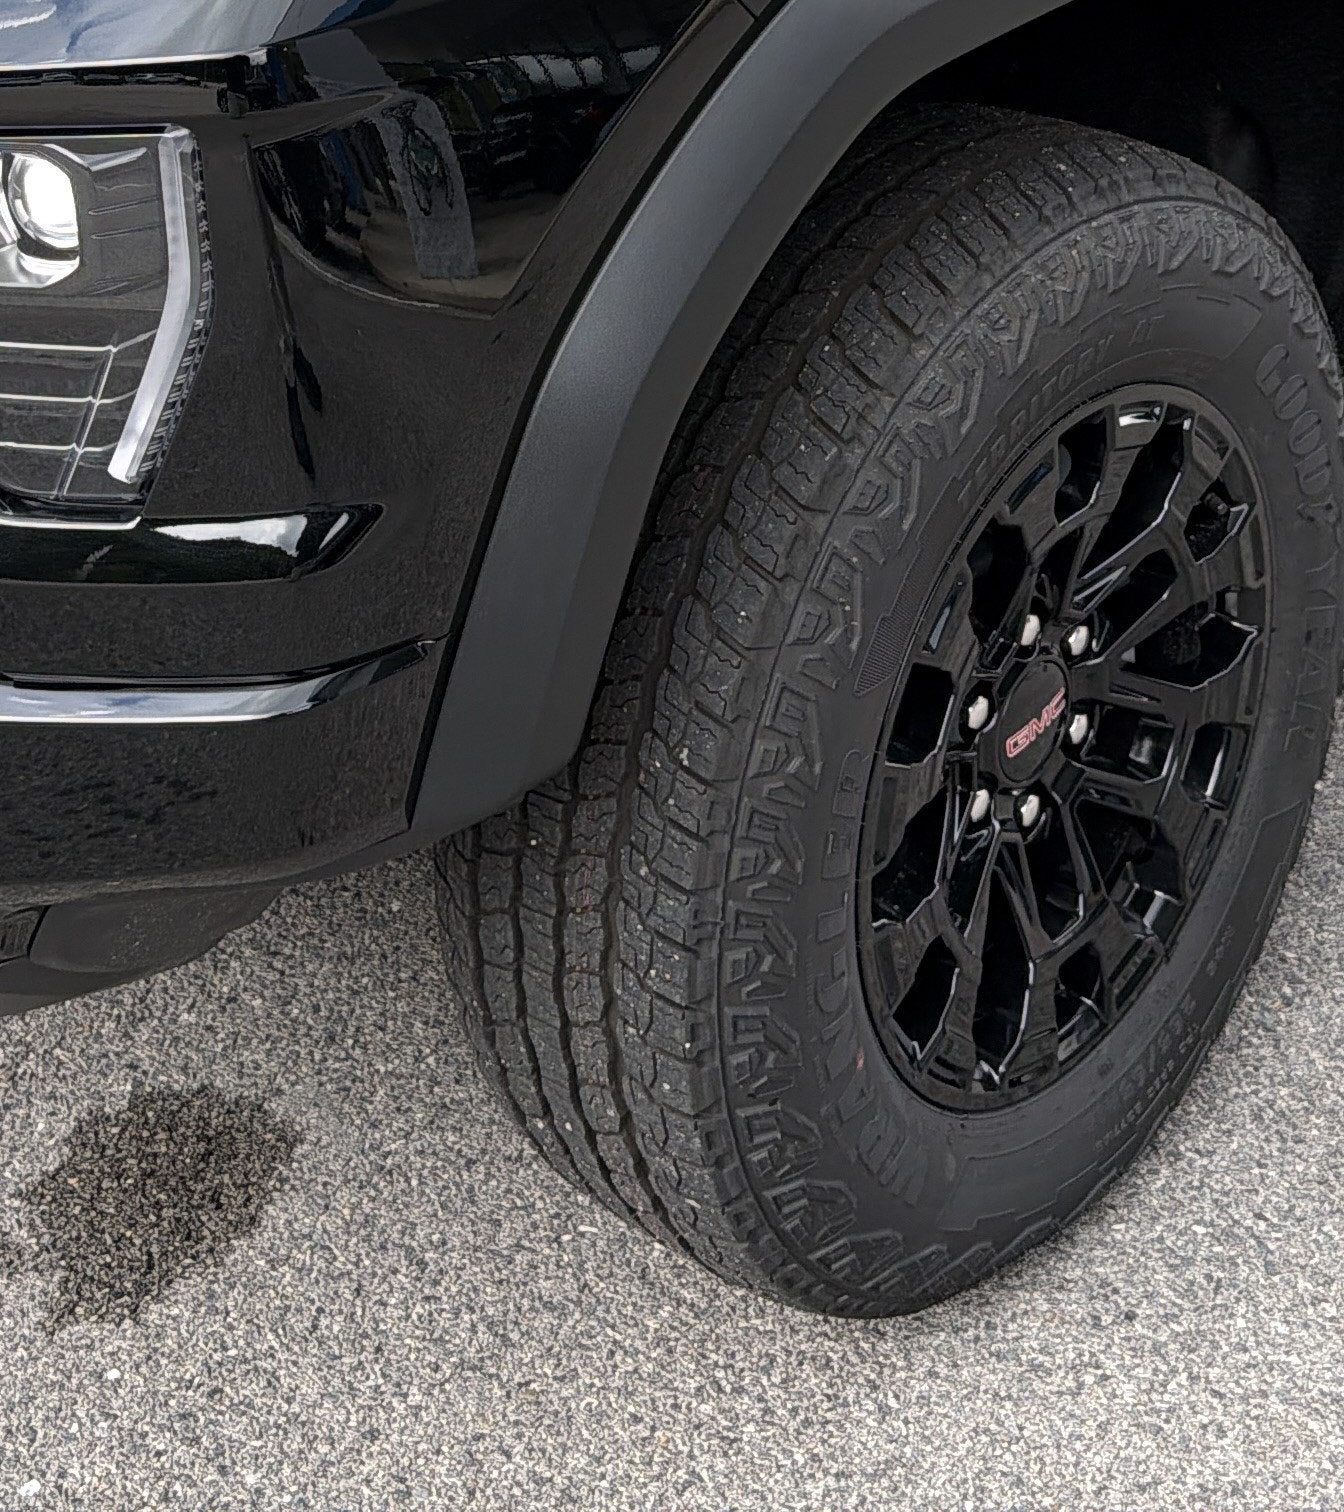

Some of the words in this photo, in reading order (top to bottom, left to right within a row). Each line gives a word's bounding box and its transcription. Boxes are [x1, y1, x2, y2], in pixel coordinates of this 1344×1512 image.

[1006, 687, 1066, 758] GMC
[1256, 343, 1341, 752] GOODYEAR
[816, 749, 927, 1207] WRANGLER
